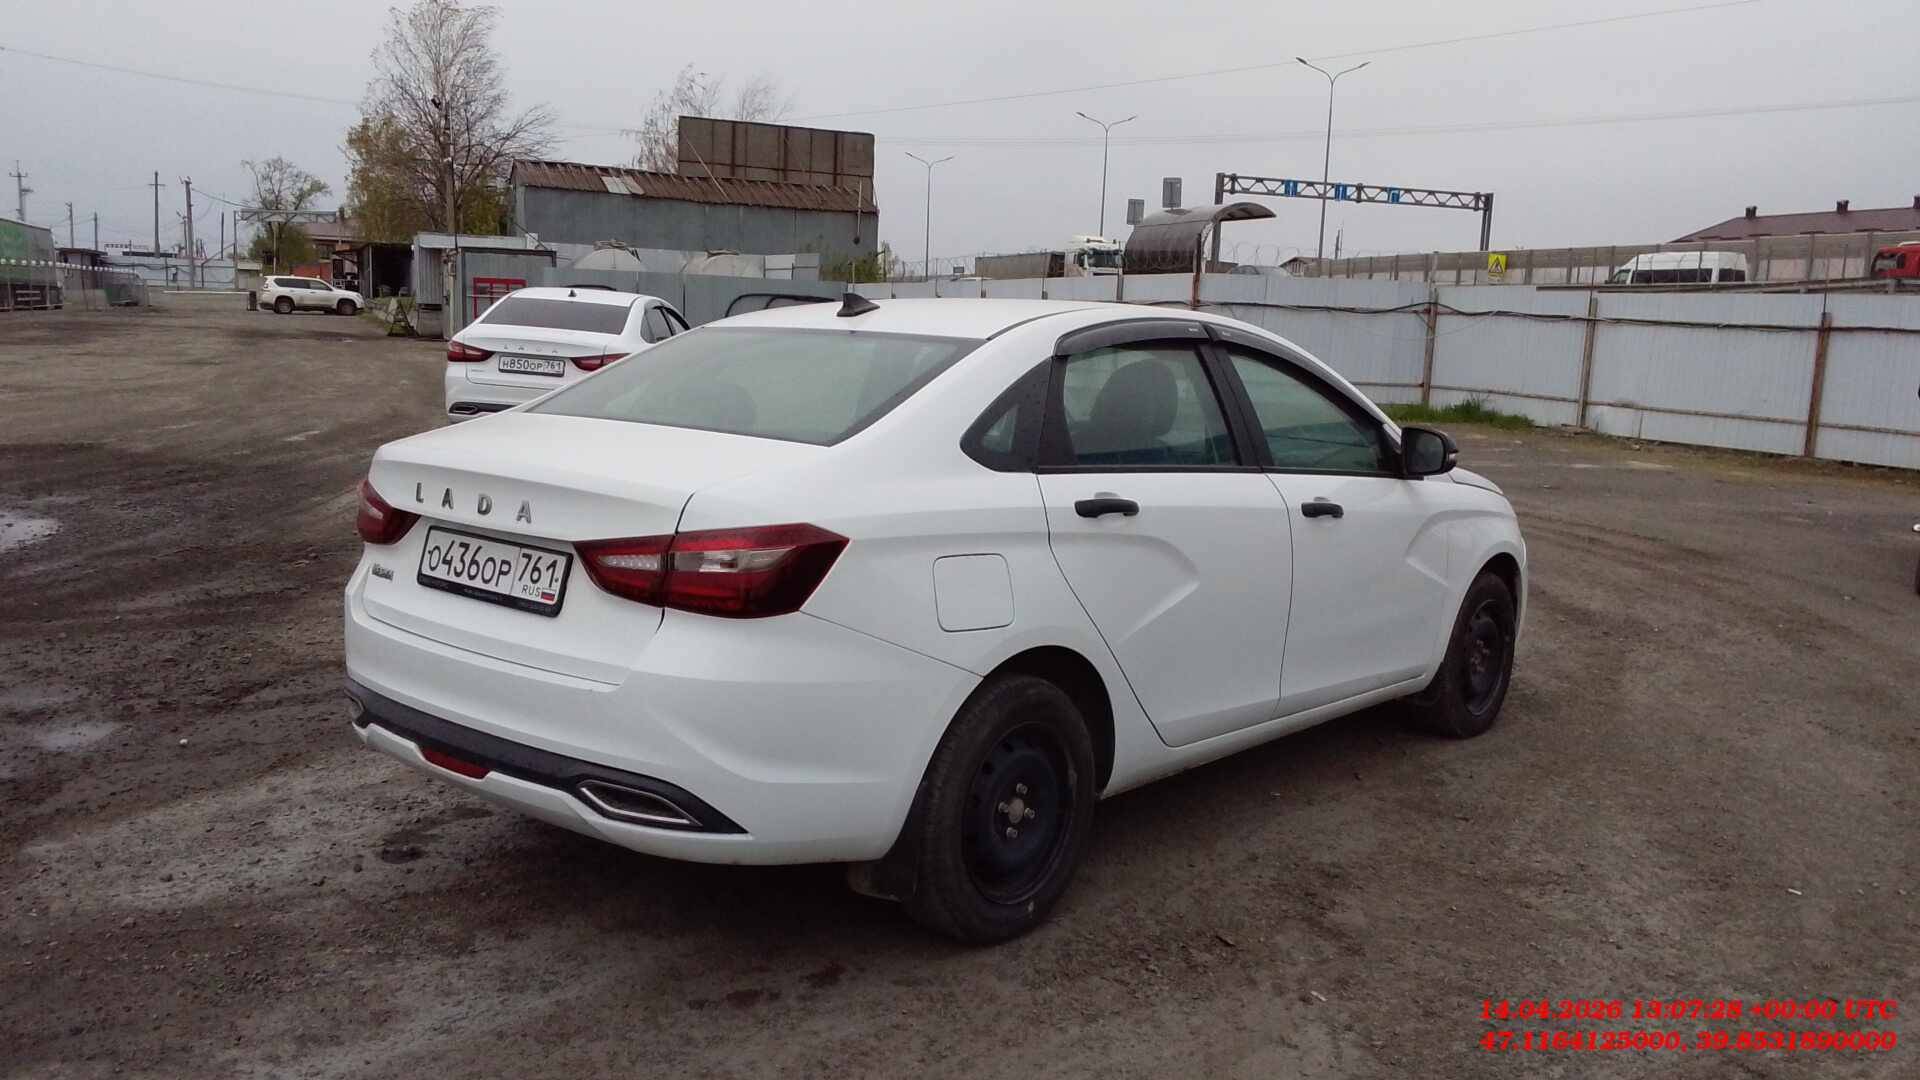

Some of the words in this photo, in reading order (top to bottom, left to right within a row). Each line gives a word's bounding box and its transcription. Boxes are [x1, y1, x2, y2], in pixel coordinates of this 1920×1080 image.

[416, 482, 532, 523] LADA
[428, 540, 512, 587] О436ОР
[518, 552, 557, 588] 761
[521, 584, 541, 597] RUS
